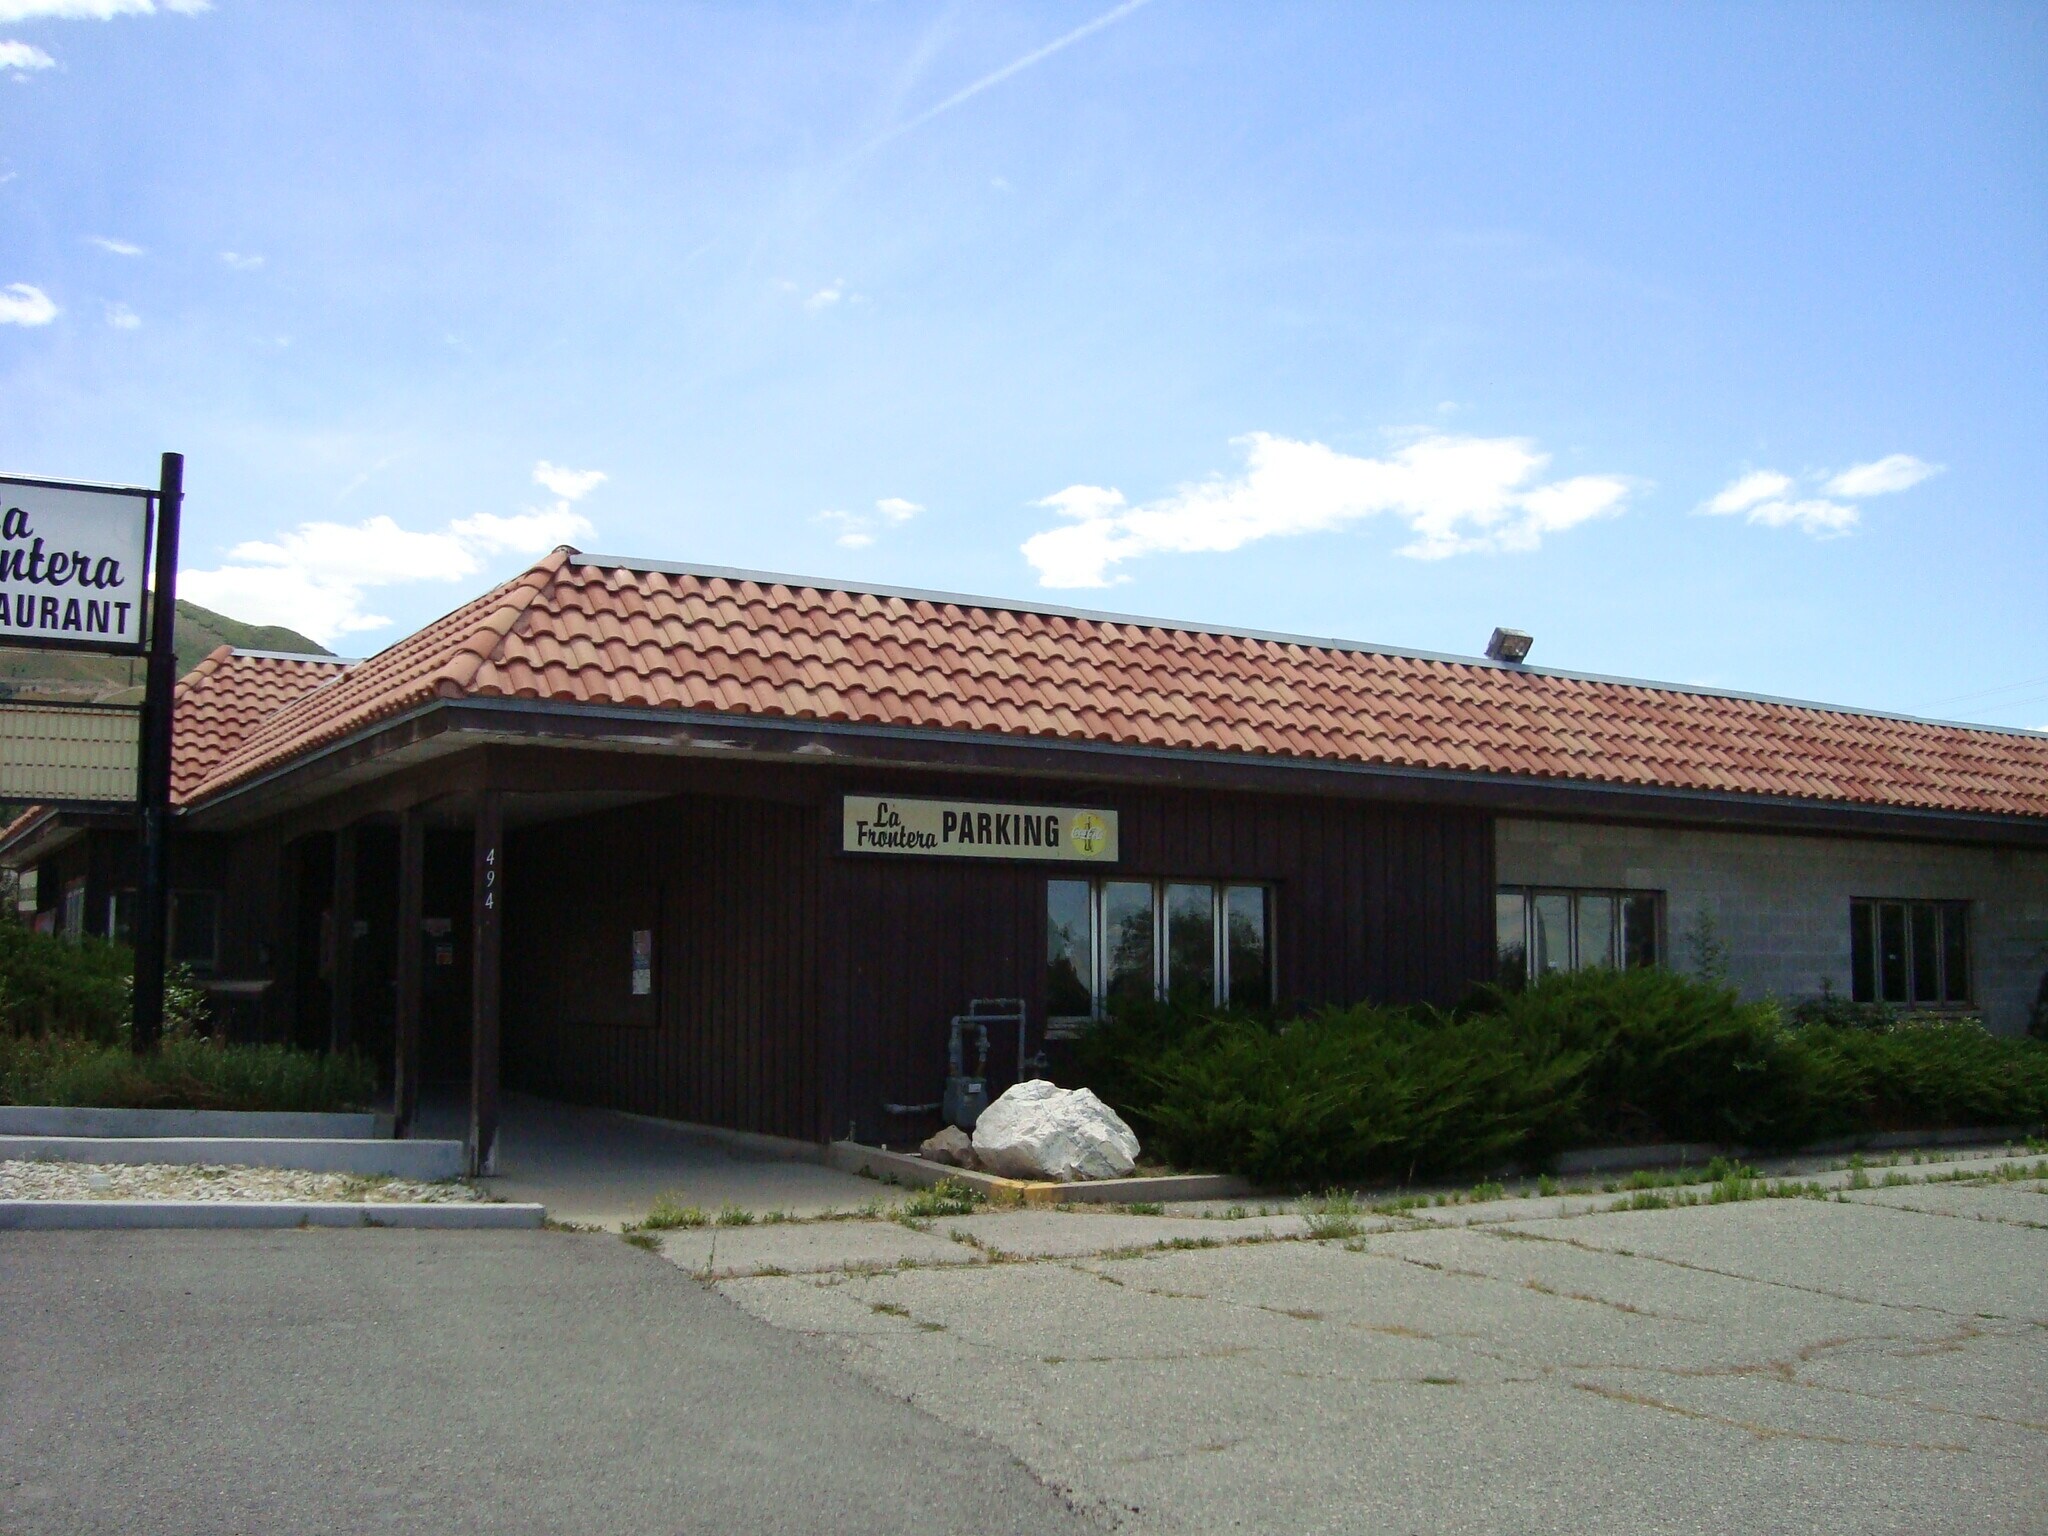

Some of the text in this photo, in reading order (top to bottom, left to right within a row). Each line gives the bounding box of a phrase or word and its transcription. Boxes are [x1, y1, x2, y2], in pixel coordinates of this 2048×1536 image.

[0, 506, 33, 540] a
[873, 802, 901, 828] La
[942, 810, 1059, 847] PARKING
[856, 820, 938, 849] Frontera
